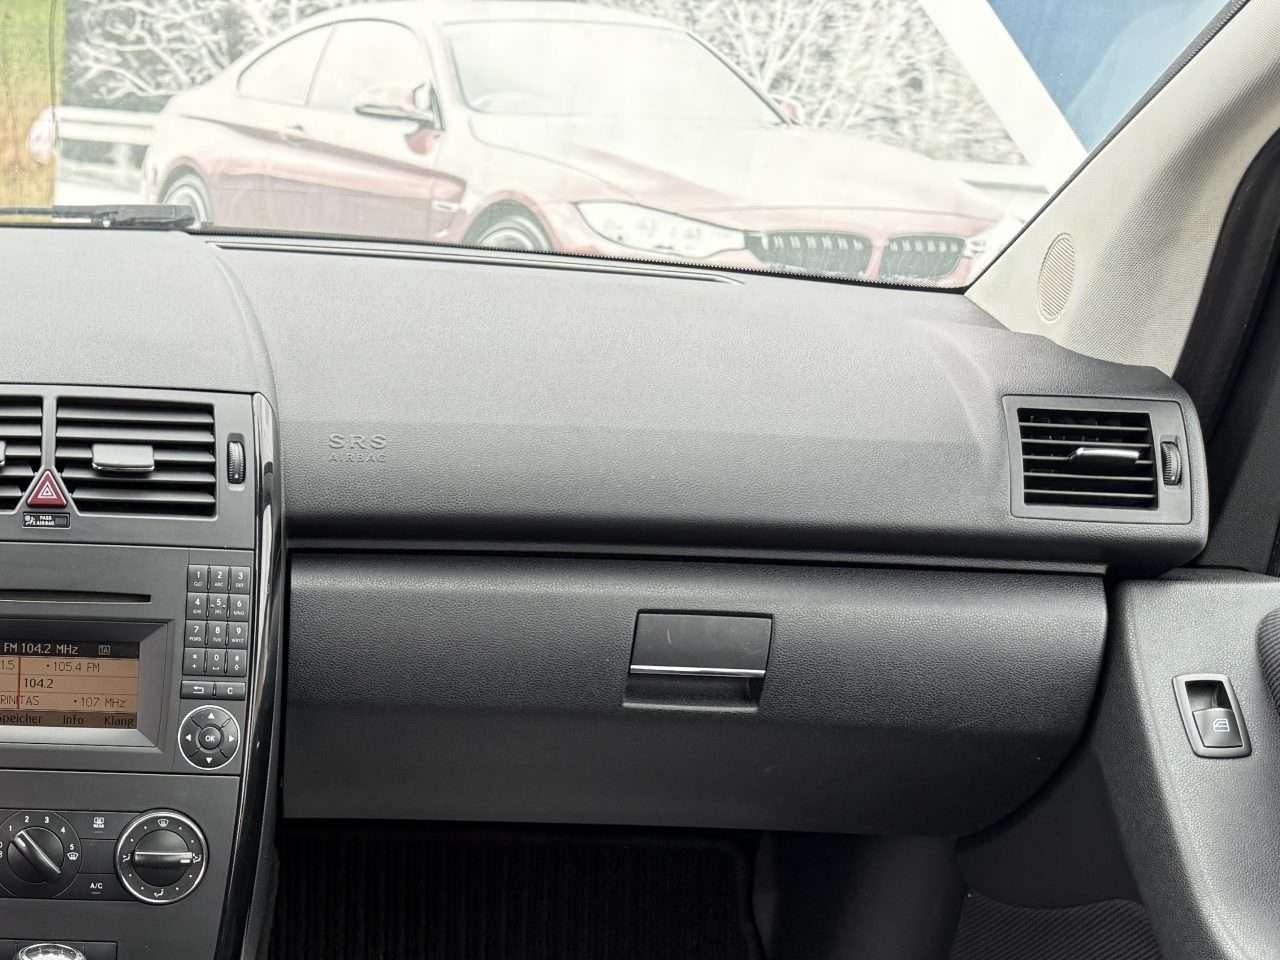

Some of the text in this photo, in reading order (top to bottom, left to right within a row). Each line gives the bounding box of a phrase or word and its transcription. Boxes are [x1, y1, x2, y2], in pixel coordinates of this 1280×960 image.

[328, 433, 386, 449] SRS
[217, 571, 223, 579] 2
[238, 571, 244, 580] 3
[195, 598, 200, 606] 4
[216, 598, 221, 606] 5
[237, 600, 242, 608] 6
[193, 625, 200, 633] 7
[236, 627, 242, 635] 9
[3, 643, 79, 655] FM 104.2 MHz
[86, 662, 100, 673] FM
[23, 678, 54, 689] 104.2
[81, 697, 127, 708] 107 MHz
[63, 714, 84, 725] Info
[104, 715, 136, 728] Klang
[24, 815, 30, 823] 2
[44, 816, 50, 824] 3
[60, 826, 66, 834] 4
